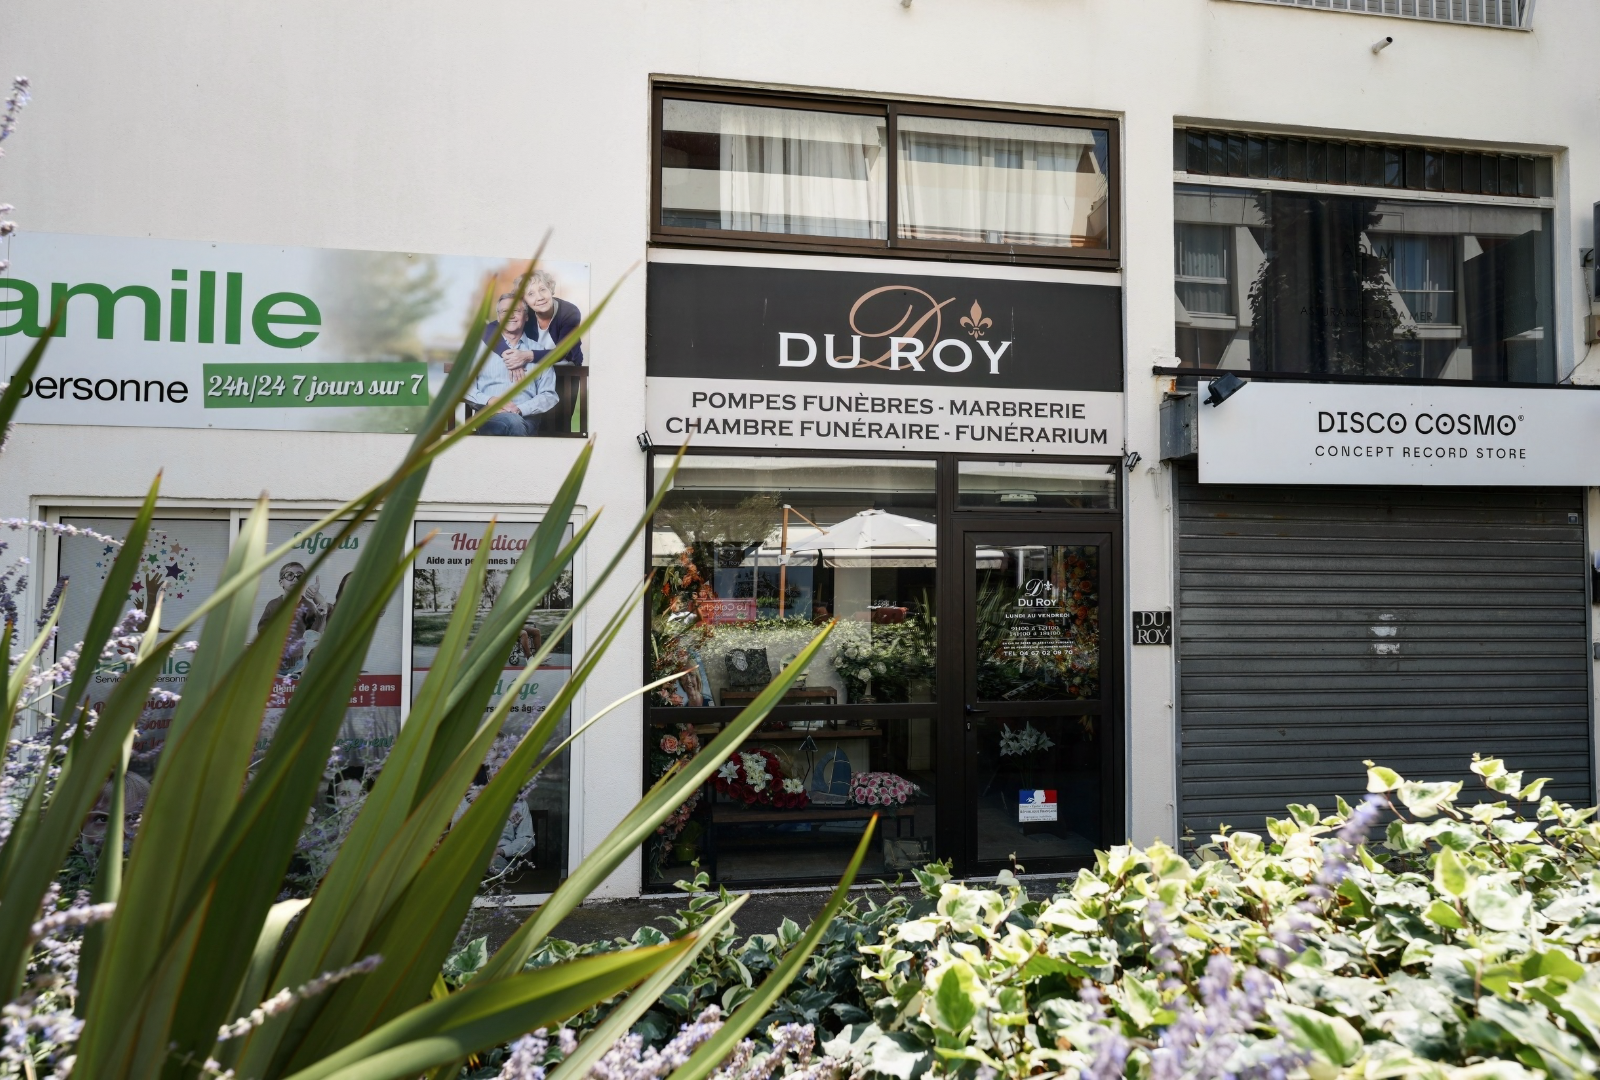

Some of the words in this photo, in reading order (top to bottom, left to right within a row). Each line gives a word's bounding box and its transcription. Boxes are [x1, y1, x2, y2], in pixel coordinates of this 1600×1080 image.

[778, 332, 861, 369] DU
[889, 336, 1012, 375] ROY
[208, 374, 286, 403] 24h/24
[292, 374, 307, 396] 7
[305, 375, 364, 402] jours
[368, 379, 404, 396] sur
[411, 374, 424, 395] 7
[692, 391, 796, 411] POMPES
[803, 392, 934, 415] FUNÈBRES
[950, 399, 1086, 420] MARBRERIE
[665, 416, 793, 437] CHAMBRE
[800, 417, 940, 440] FUNÉRAIRE
[955, 422, 1107, 445] FUNÉRARIUM
[1318, 411, 1407, 434] DISCO
[1315, 445, 1394, 457] CONCEPT
[1402, 446, 1468, 458] RECORD
[1476, 447, 1526, 460] STORE
[291, 531, 359, 555] Enfats
[451, 532, 534, 551] Hadica
[426, 556, 445, 565] Aide
[465, 558, 508, 566] pennes
[1140, 611, 1165, 627] DU
[1136, 629, 1169, 644] ROY
[95, 657, 192, 675] Falle
[358, 683, 370, 692] de
[371, 683, 378, 692] 3
[380, 684, 396, 692] ans
[521, 703, 546, 714] âges
